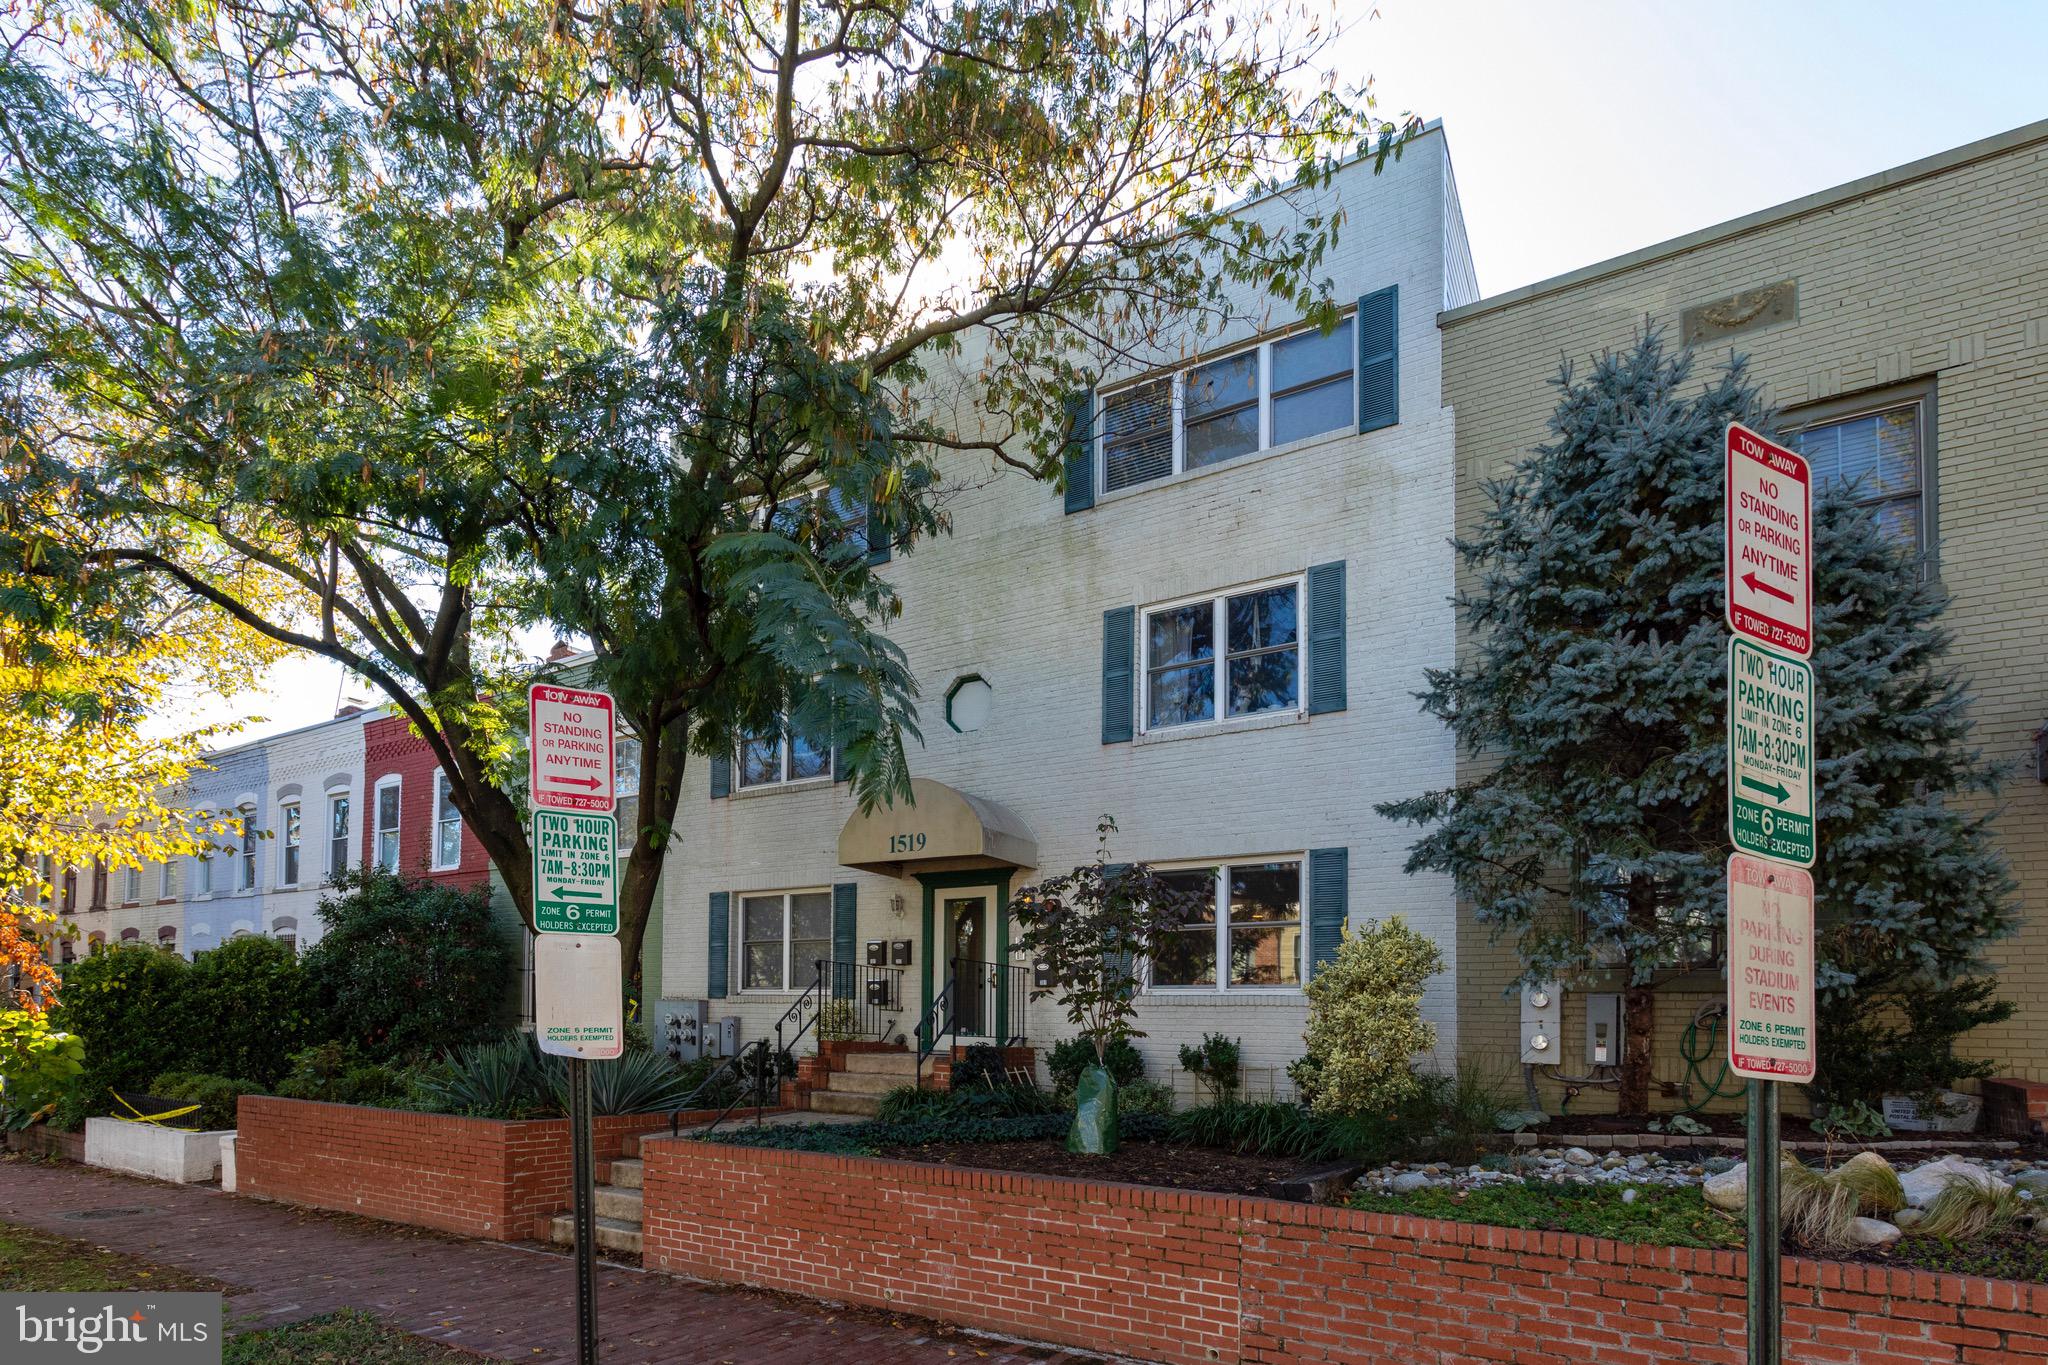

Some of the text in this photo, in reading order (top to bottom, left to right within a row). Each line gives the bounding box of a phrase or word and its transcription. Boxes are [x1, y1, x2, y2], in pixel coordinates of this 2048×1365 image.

[1739, 436, 1798, 476] TOW AWAY
[1760, 477, 1778, 500] NO
[1740, 491, 1799, 532] STANDING
[1738, 518, 1801, 556] OR PARKING
[1741, 545, 1798, 582] ANYTIME
[1734, 610, 1806, 650] IF TOWED 727-5000
[1739, 649, 1804, 694] TWO HOUR
[543, 689, 601, 706] TOW AWAY
[1738, 680, 1804, 723] PARKING
[563, 711, 582, 723] NO
[1741, 706, 1803, 739] LIMIT IN ZONE 6
[544, 723, 602, 739] STANDING
[542, 738, 604, 754] OR PARKING
[1737, 723, 1806, 770] 7AM-8:30PM
[545, 754, 602, 769] ANYTIME
[1743, 754, 1802, 780] MONDAY-FRIDAY
[538, 794, 610, 809] IF TOWED 727-5000
[540, 815, 609, 836] TWO HOUR
[1736, 804, 1810, 837] ZONE 6 PERMIT
[542, 832, 609, 851] PARKING
[889, 832, 927, 853] 1519
[1737, 828, 1811, 859] HOLDERS EXCEPTED
[541, 849, 610, 862] LIMIT IN ZONE 6
[541, 859, 611, 878] 7AM-8:30PM
[541, 904, 612, 921] ZONE 6 PERMIT
[539, 920, 613, 932] HOLDERS EXCEPTED
[1749, 944, 1795, 968] DURING
[1744, 966, 1800, 992] STADIUM
[1749, 991, 1796, 1014] EVENTS
[1739, 1019, 1806, 1037] ZONE 6 PERMIT
[1739, 1033, 1806, 1050] HOLDERS EXEMPTED
[1738, 1057, 1808, 1074] IF TOWED 727-5000
